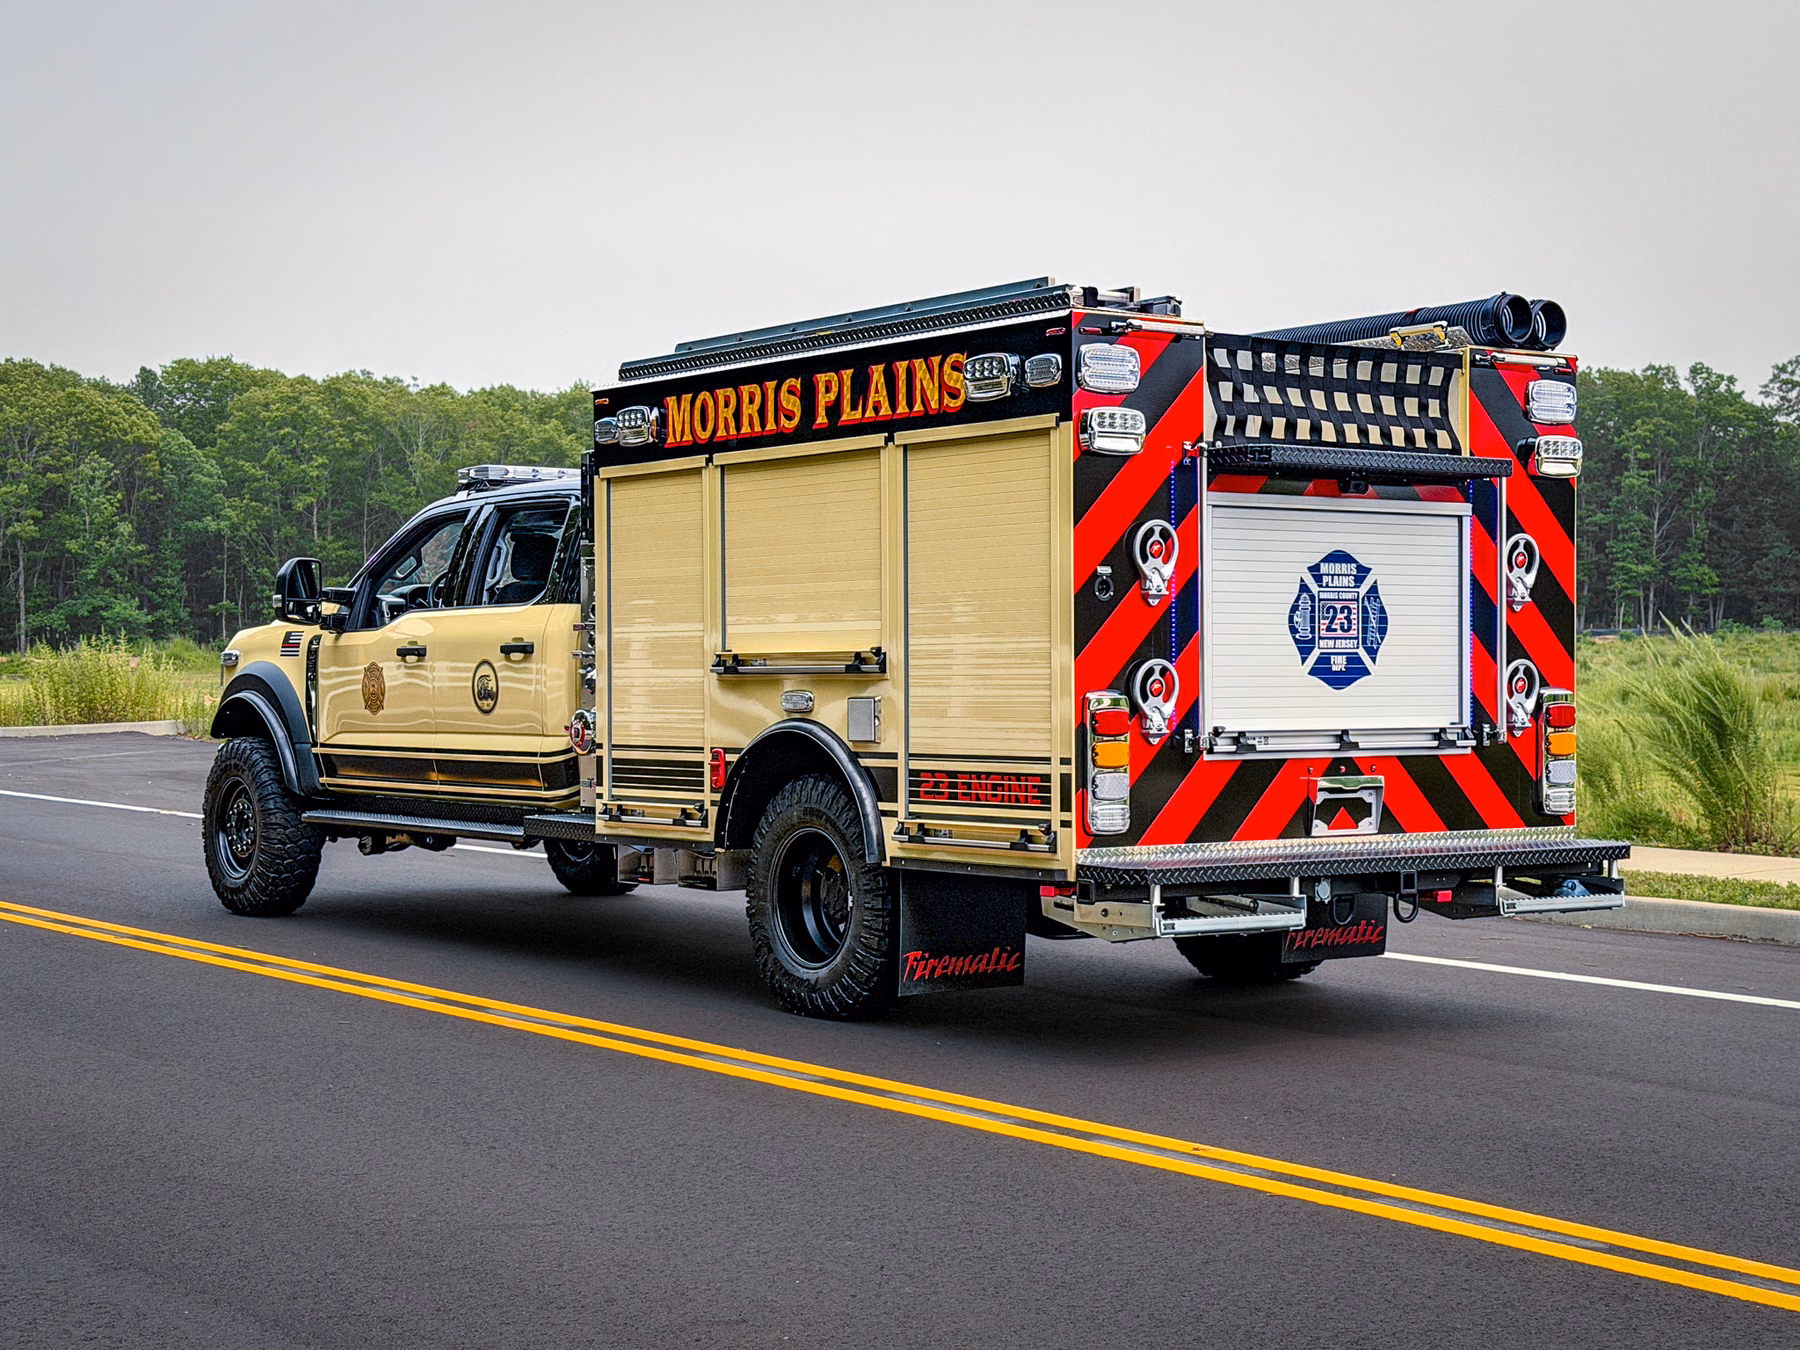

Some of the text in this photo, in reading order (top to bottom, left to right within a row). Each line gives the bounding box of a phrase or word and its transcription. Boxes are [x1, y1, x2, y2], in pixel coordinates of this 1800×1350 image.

[664, 350, 968, 448] MORRIS PLAINS
[1320, 563, 1357, 575] MORRIS
[1322, 575, 1355, 587] PLAINS
[1325, 604, 1353, 633] 23
[1319, 639, 1358, 649] NEW JERSEY
[1331, 656, 1347, 664] FIRE
[919, 772, 1042, 805] 23 ENGINE
[903, 946, 1021, 983] Firematic
